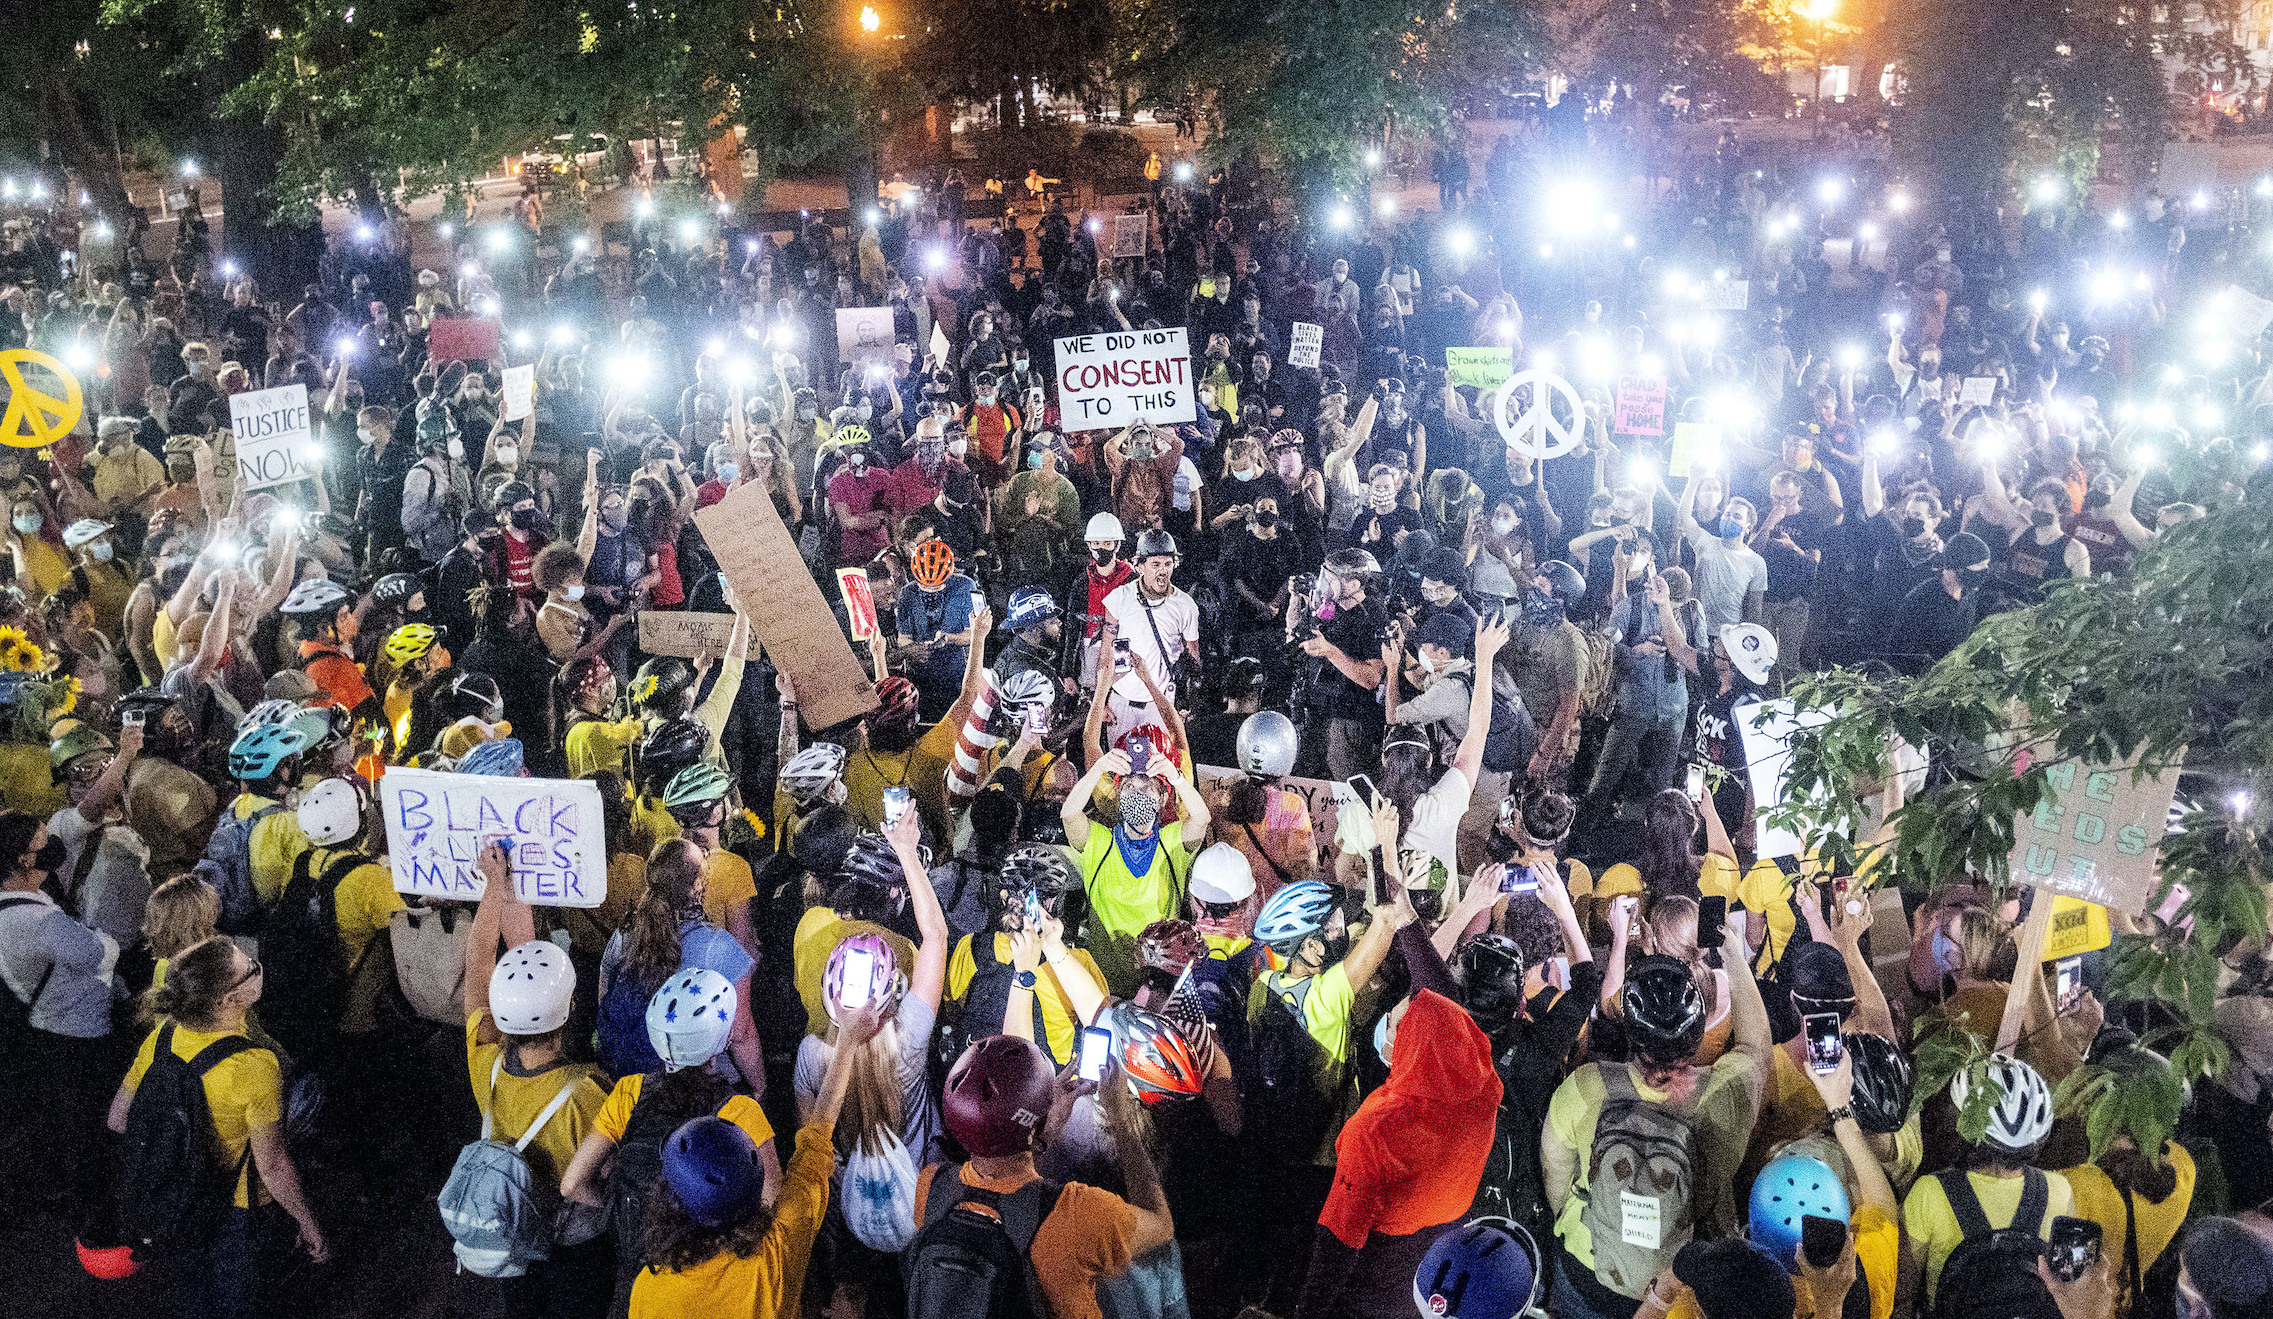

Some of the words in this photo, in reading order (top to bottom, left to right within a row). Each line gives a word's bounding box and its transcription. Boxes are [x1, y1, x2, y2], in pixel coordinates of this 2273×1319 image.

[1298, 324, 1318, 332] BLACK
[1298, 330, 1317, 338] LIVES
[1063, 336, 1095, 355] WE
[1106, 335, 1135, 351] DID
[1143, 331, 1179, 345] NOT
[1295, 336, 1320, 344] MATTER
[1293, 345, 1319, 353] DEFUND
[1292, 356, 1315, 366] POLICE
[1062, 357, 1188, 392] CONSENT
[1077, 397, 1112, 418] TO
[1127, 390, 1176, 411] THIS
[1620, 403, 1654, 418] posse
[235, 406, 307, 440] JUSTICE
[1626, 412, 1662, 429] HOME
[240, 448, 312, 482] NOW
[398, 789, 578, 837] BLACK
[447, 836, 573, 870] LIES
[412, 861, 585, 899] MATER
[1621, 1198, 1655, 1210] MATERNAL
[1624, 1228, 1654, 1241] SHIELD
